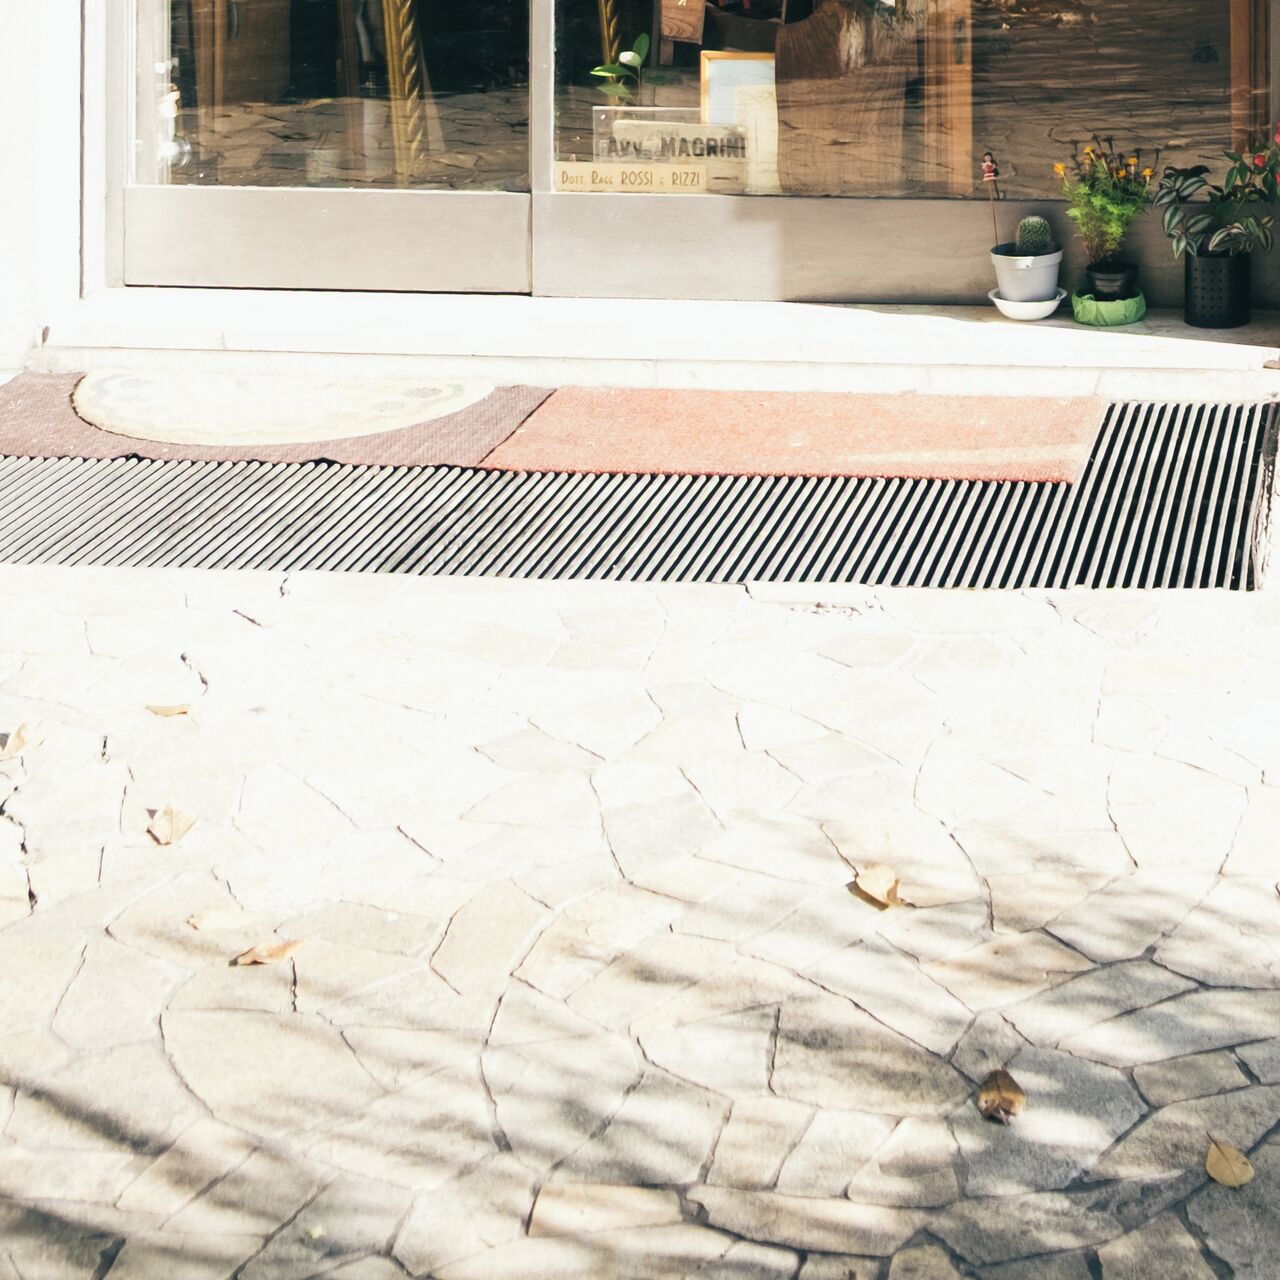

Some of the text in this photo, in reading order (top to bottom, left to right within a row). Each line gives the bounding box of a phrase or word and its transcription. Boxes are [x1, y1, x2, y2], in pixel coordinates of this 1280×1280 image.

[661, 137, 747, 158] MAGRINI
[621, 171, 653, 186] ROSSI
[672, 171, 700, 187] RIZZI
